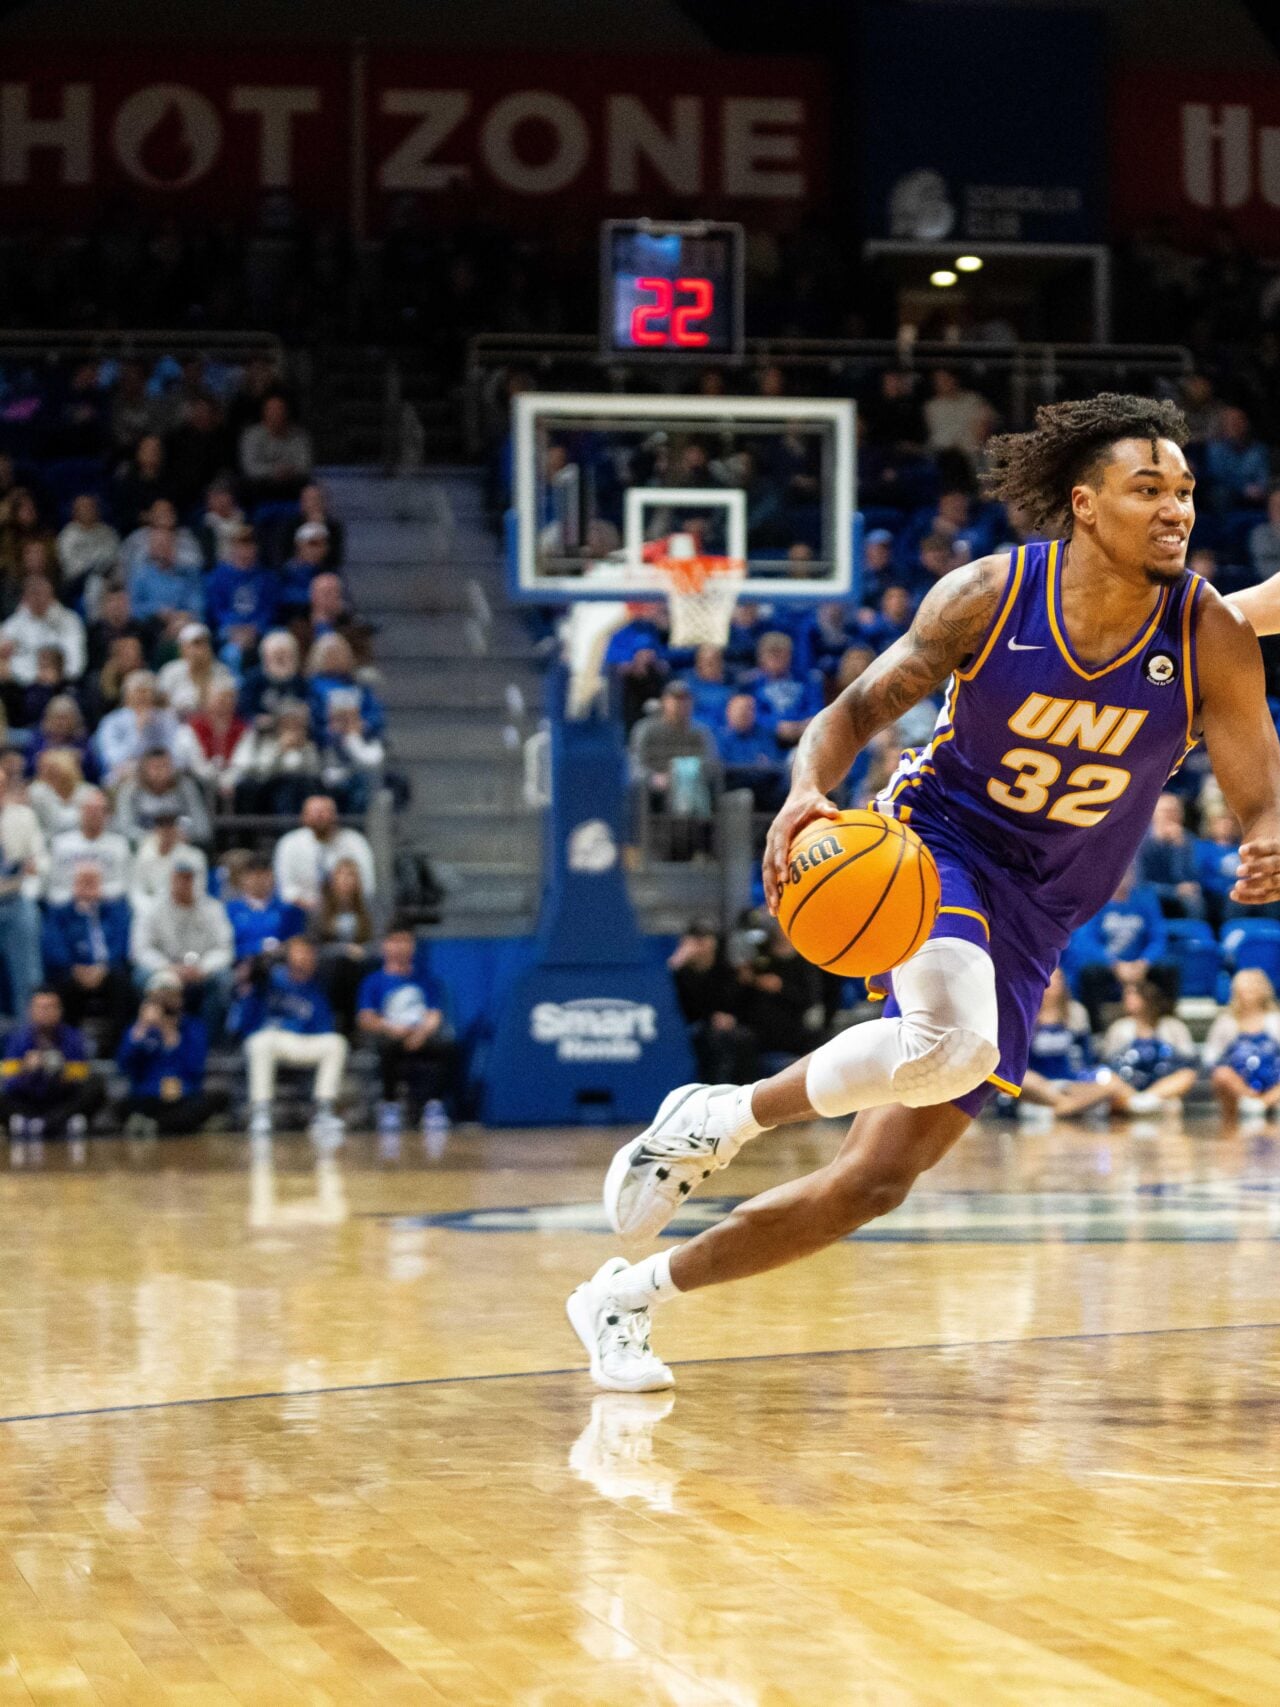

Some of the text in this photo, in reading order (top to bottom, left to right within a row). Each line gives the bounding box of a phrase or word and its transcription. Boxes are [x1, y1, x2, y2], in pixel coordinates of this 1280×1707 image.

[0, 82, 812, 198] HOT ZONE
[630, 277, 714, 347] 22
[1007, 691, 1149, 757] UNI
[986, 747, 1131, 828] 32
[530, 1002, 657, 1042] Smart
